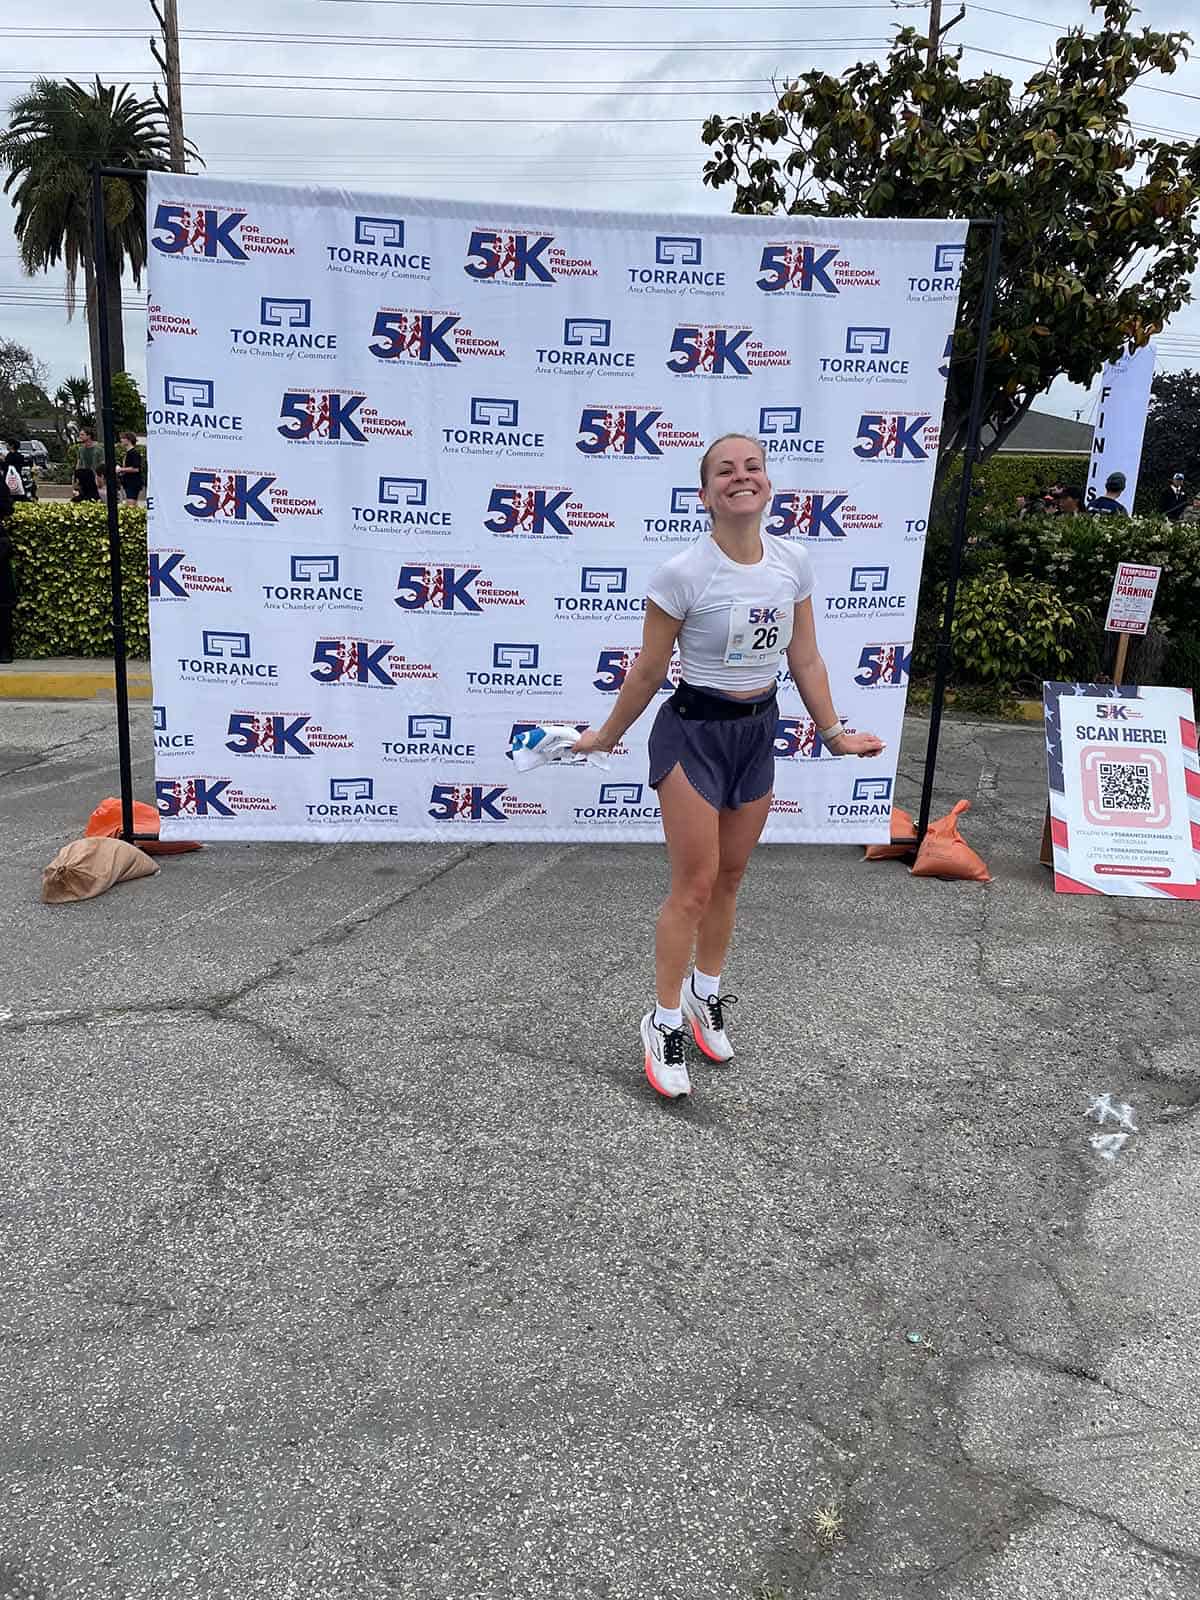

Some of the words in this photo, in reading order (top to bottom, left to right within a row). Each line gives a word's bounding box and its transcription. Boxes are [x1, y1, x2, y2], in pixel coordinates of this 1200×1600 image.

[152, 205, 250, 260] 5K
[240, 225, 259, 234] FOR
[242, 235, 288, 244] FREEDOM
[244, 244, 295, 254] RUN/WALK
[326, 246, 430, 270] TORRANCE
[465, 232, 556, 282] 5K
[550, 258, 592, 266] FREEDOM
[345, 266, 378, 276] Chamber
[551, 267, 598, 275] RUN/WALK
[628, 268, 725, 285] TORRANCE
[757, 246, 841, 292] 5K
[646, 286, 677, 294] Chamber
[231, 329, 337, 349] TORRANCE
[370, 312, 462, 362] 5K
[455, 338, 499, 346] FREEDOM
[250, 348, 284, 357] Chamber
[457, 347, 505, 355] RUN/WALK
[536, 349, 634, 366] TORRANCE
[667, 328, 753, 374] 5K
[820, 358, 910, 373] TORRANCE
[280, 392, 370, 442] 5K
[361, 408, 378, 416] FOR
[146, 410, 242, 430] TORRANCE
[156, 427, 190, 437] Chamber
[443, 428, 543, 447] TORRANCE
[577, 409, 664, 454] 5K
[854, 415, 930, 458] 5K
[461, 447, 493, 455] Chamber
[1087, 387, 1112, 501] FINIS
[184, 472, 279, 521] 5K
[272, 498, 316, 506] FREEDOM
[273, 507, 322, 515] RUN/WALK
[351, 507, 451, 525] TORRANCE
[485, 489, 573, 534] 5K
[765, 494, 849, 536] 5K
[369, 525, 401, 534] Chamber
[644, 519, 713, 532] TORRAN
[182, 574, 223, 582] FREEDOM
[1119, 576, 1133, 586] NO
[184, 583, 232, 591] RUN/WALK
[263, 586, 365, 600] TORRANCE
[395, 566, 484, 611] 5K
[1116, 586, 1154, 598] PARKING
[827, 595, 906, 609] TORRANCE
[748, 608, 778, 624] 5K
[752, 626, 779, 650] 26
[177, 659, 277, 677] TORRANCE
[311, 640, 397, 684] 5K
[196, 676, 229, 684] Chamber
[466, 672, 562, 686] TORRANCE
[1096, 704, 1128, 720] 5K
[226, 715, 314, 754] 5K
[1076, 725, 1119, 742] SCAN
[1122, 727, 1167, 744] HERE!
[383, 742, 474, 755] TORRANCE
[156, 781, 237, 816] 5K
[428, 786, 509, 820] 5K
[305, 804, 397, 815] TORRANCE
[573, 808, 661, 818] TORRANCE
[827, 804, 891, 816] TORRAN
